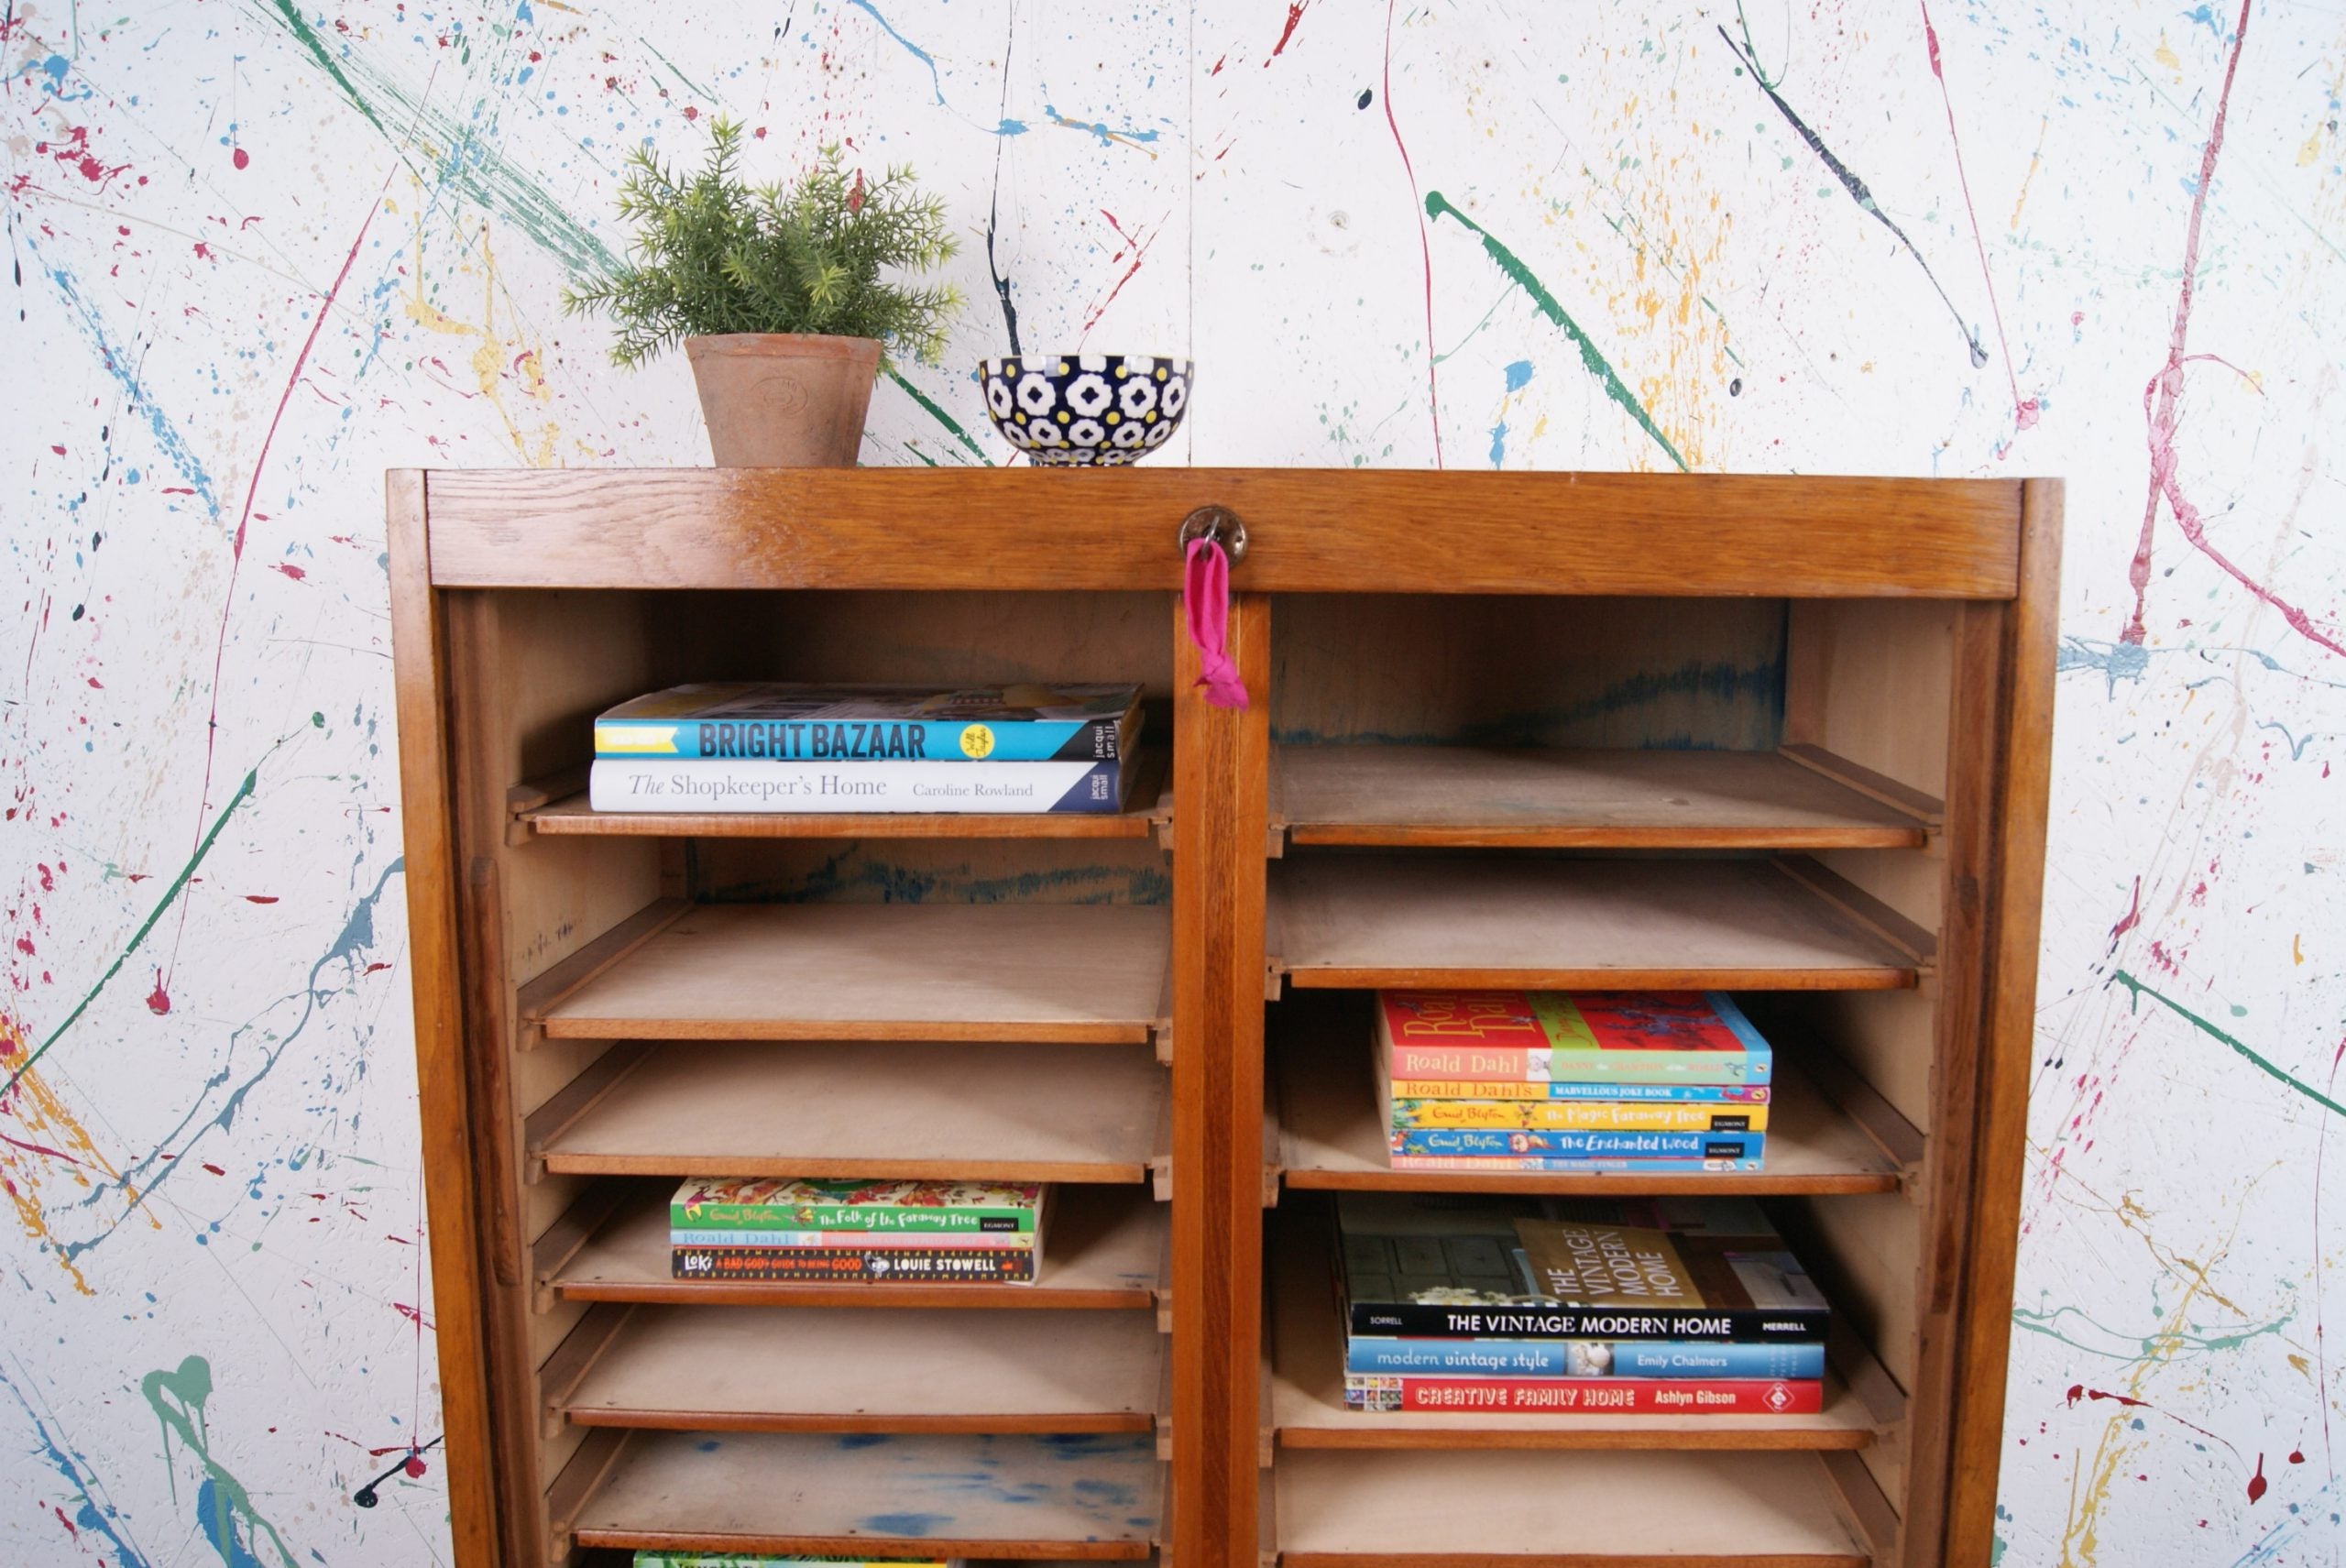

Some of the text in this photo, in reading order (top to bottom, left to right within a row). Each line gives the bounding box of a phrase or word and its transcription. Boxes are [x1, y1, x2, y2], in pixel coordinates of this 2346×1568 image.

[699, 723, 926, 758] BRIGHT BAZAAR
[1093, 726, 1104, 759] jacqui
[1105, 726, 1115, 759] small
[629, 774, 887, 801] The Shopkeeper's Home
[913, 783, 1034, 797] Caroline Rowland
[1090, 774, 1101, 800] jacqui
[1100, 774, 1109, 800] small
[1406, 1054, 1518, 1073] Roald Dahl
[1407, 1082, 1672, 1098] Roald Dahl's MARVELLOUS JOKE BOOK
[1432, 1107, 1506, 1122] Enid Blyton
[1566, 1108, 1608, 1123] Magic
[1611, 1108, 1672, 1124] Faraway
[1675, 1110, 1705, 1124] Tree
[1428, 1133, 1503, 1150] Enid Blyton
[1560, 1135, 1699, 1151] The Enchanted Wood
[1708, 1146, 1741, 1155] EGMONT
[709, 1209, 782, 1223] Enid Blyton
[819, 1210, 979, 1228] The Folk of the Faraway Tree
[683, 1233, 790, 1245] Roald Dahl
[715, 1258, 723, 1269] A
[723, 1257, 743, 1270] BAD
[831, 1257, 862, 1270] GOOD
[894, 1258, 996, 1271] LOUIE STOWELL
[1562, 1228, 1615, 1295] VINTAGE
[1594, 1230, 1650, 1296] MODERN
[1547, 1268, 1583, 1295] THE
[1635, 1252, 1683, 1297] HOME
[1370, 1316, 1403, 1326] SORRELL
[1447, 1314, 1731, 1334] THE VINTAGE MODERN HOME
[1762, 1321, 1807, 1332] MERRELL
[1377, 1349, 1550, 1371] modern vintage style
[1638, 1354, 1727, 1369] Emily Chalmers
[1416, 1387, 1636, 1407] CREATIVE FAMILY HOME
[1654, 1389, 1737, 1405] Ashlyn Gibson
